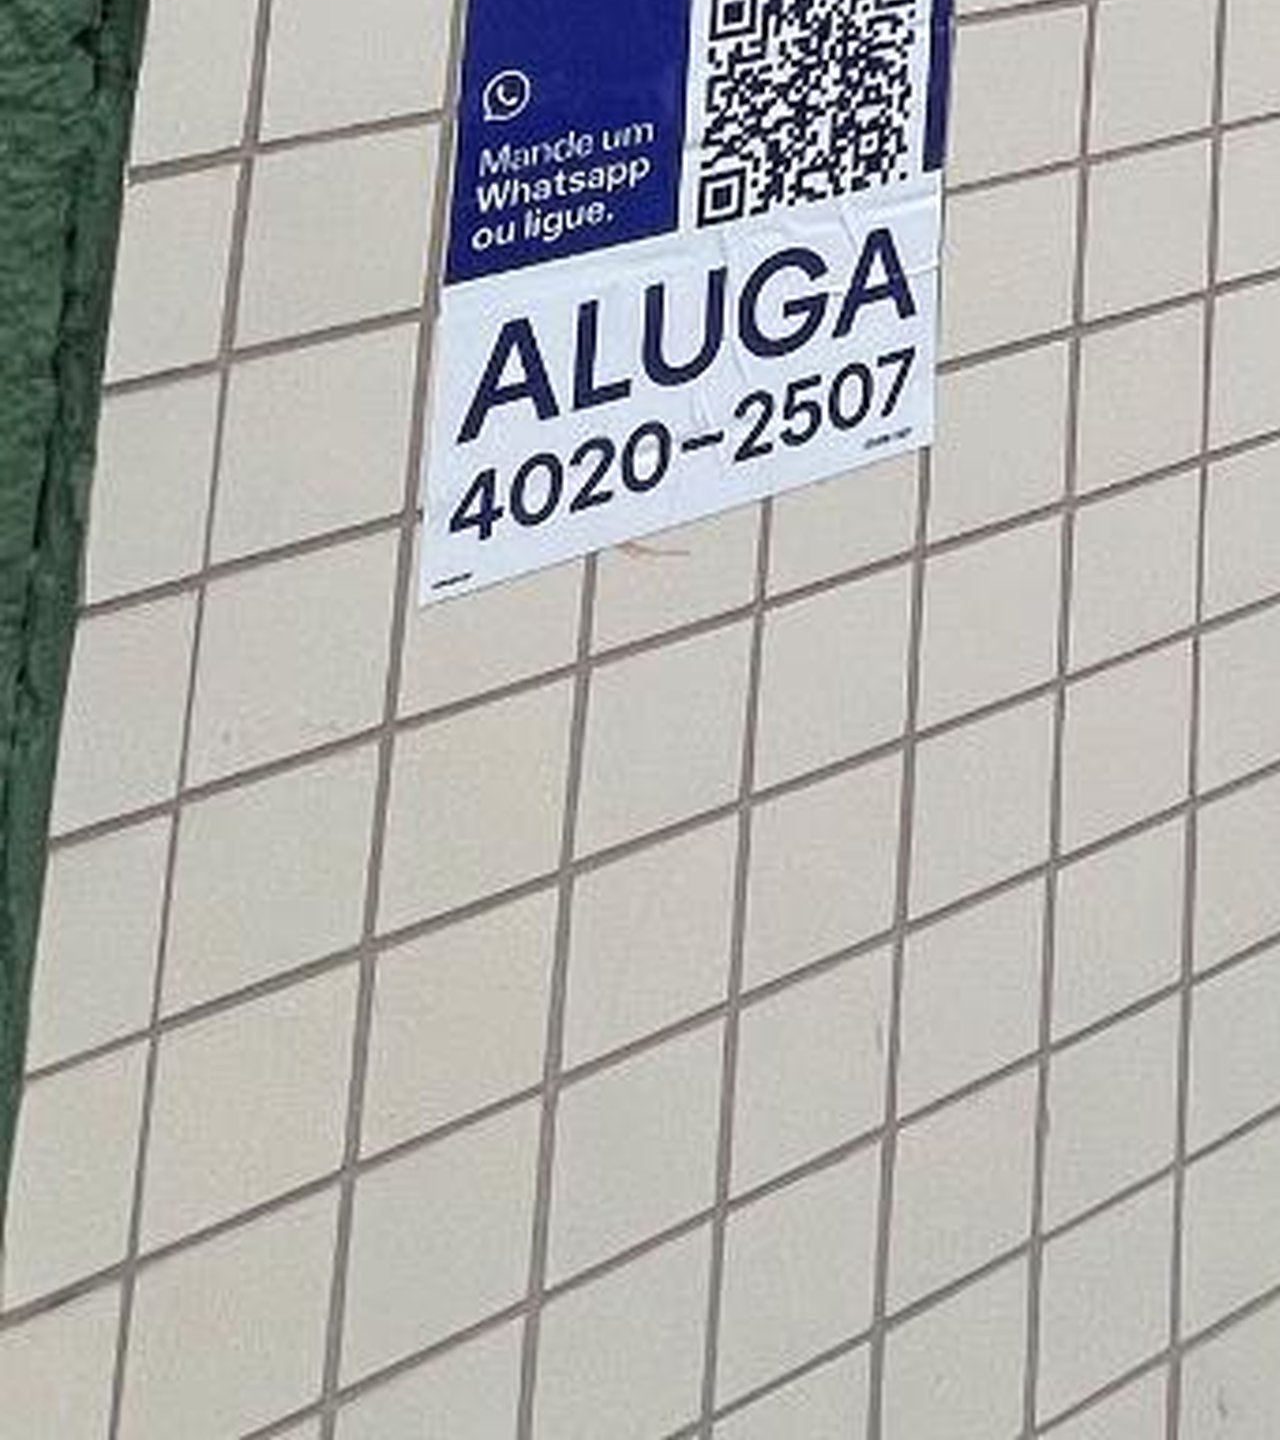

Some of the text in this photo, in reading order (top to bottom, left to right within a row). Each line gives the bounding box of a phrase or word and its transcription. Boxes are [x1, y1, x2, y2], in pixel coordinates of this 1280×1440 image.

[478, 122, 655, 178] Mande um
[475, 156, 651, 214] Whatsapp
[471, 202, 614, 252] ou ligue.
[456, 227, 917, 446] ALUGA
[448, 346, 918, 543] 4020-2507
